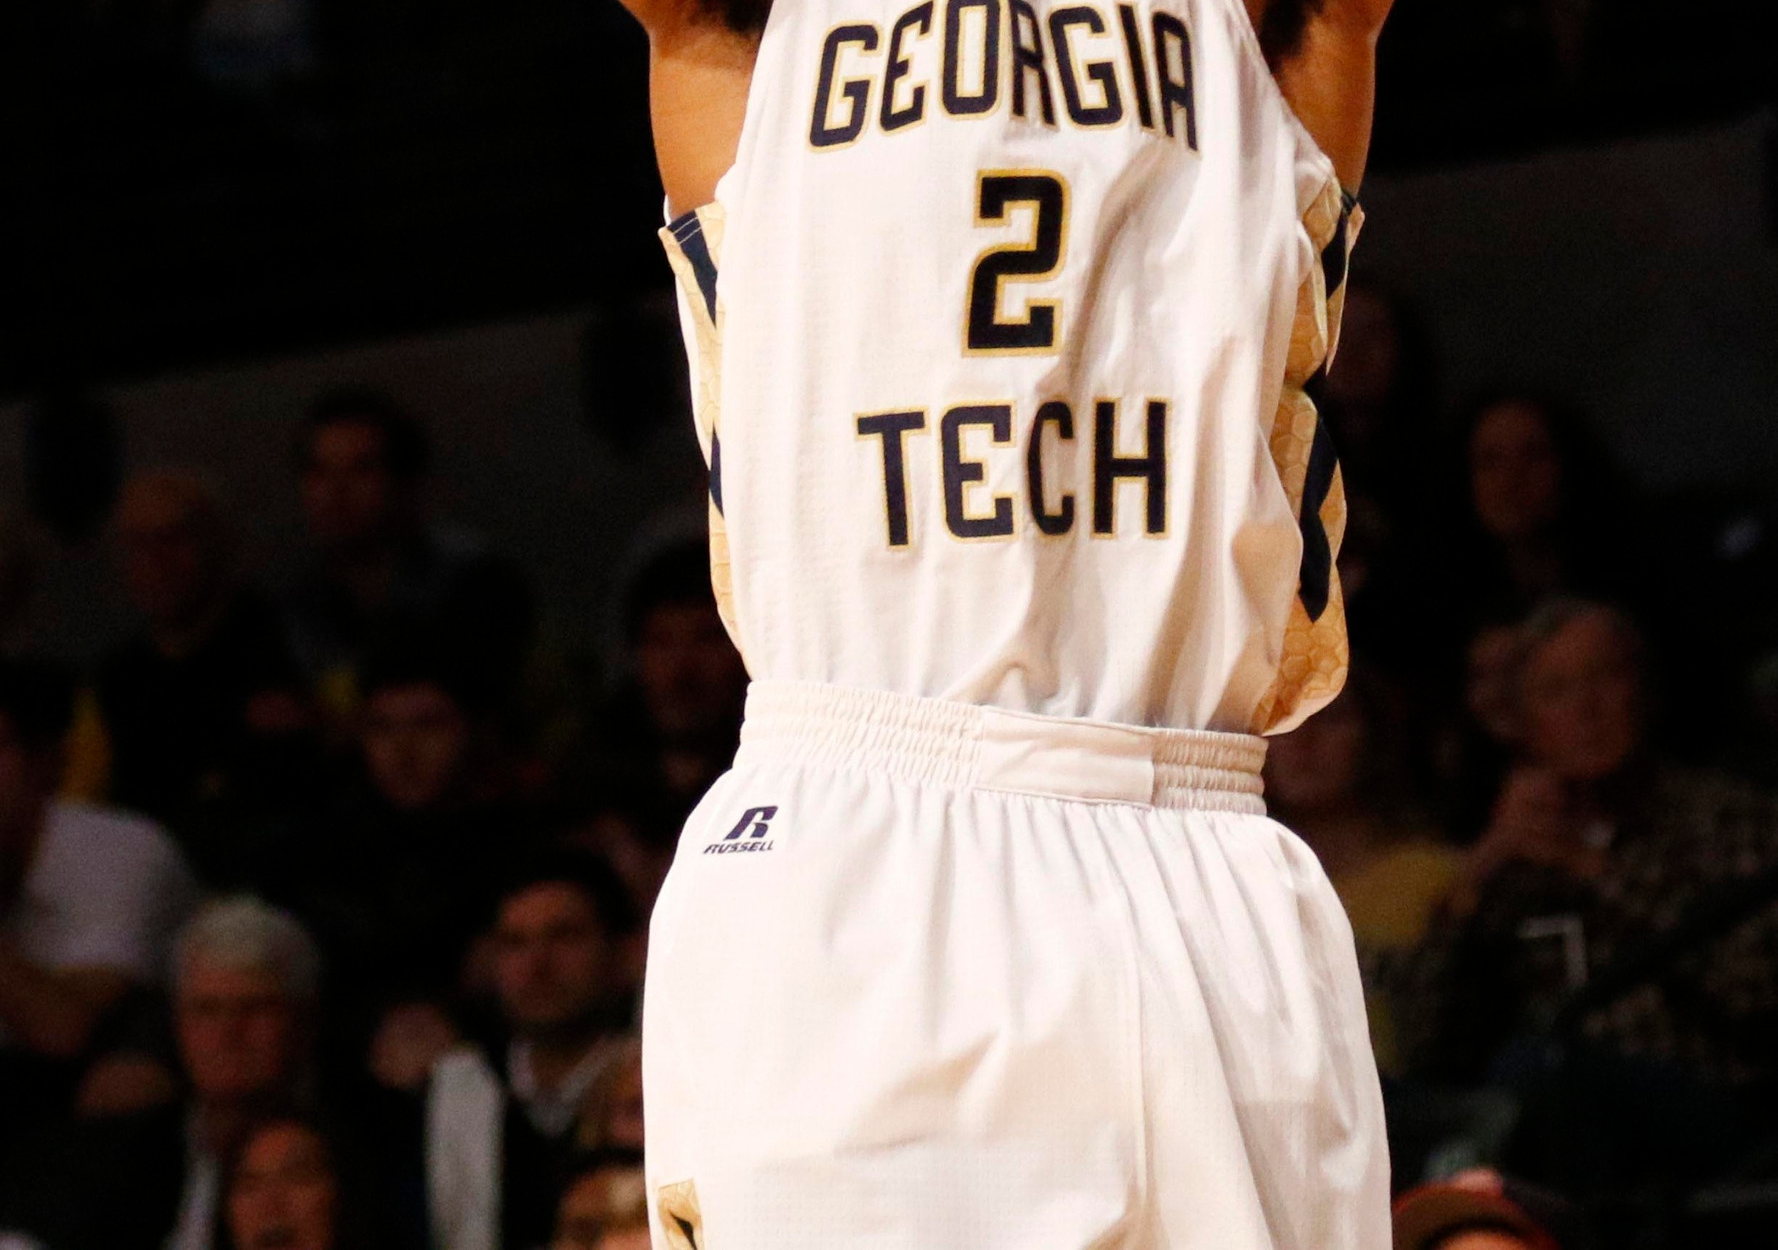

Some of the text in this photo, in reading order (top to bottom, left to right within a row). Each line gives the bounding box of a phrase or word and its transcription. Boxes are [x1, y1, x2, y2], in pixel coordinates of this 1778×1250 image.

[962, 168, 1072, 358] 2
[854, 397, 1172, 550] TECH
[703, 840, 774, 854] RUSSELL
